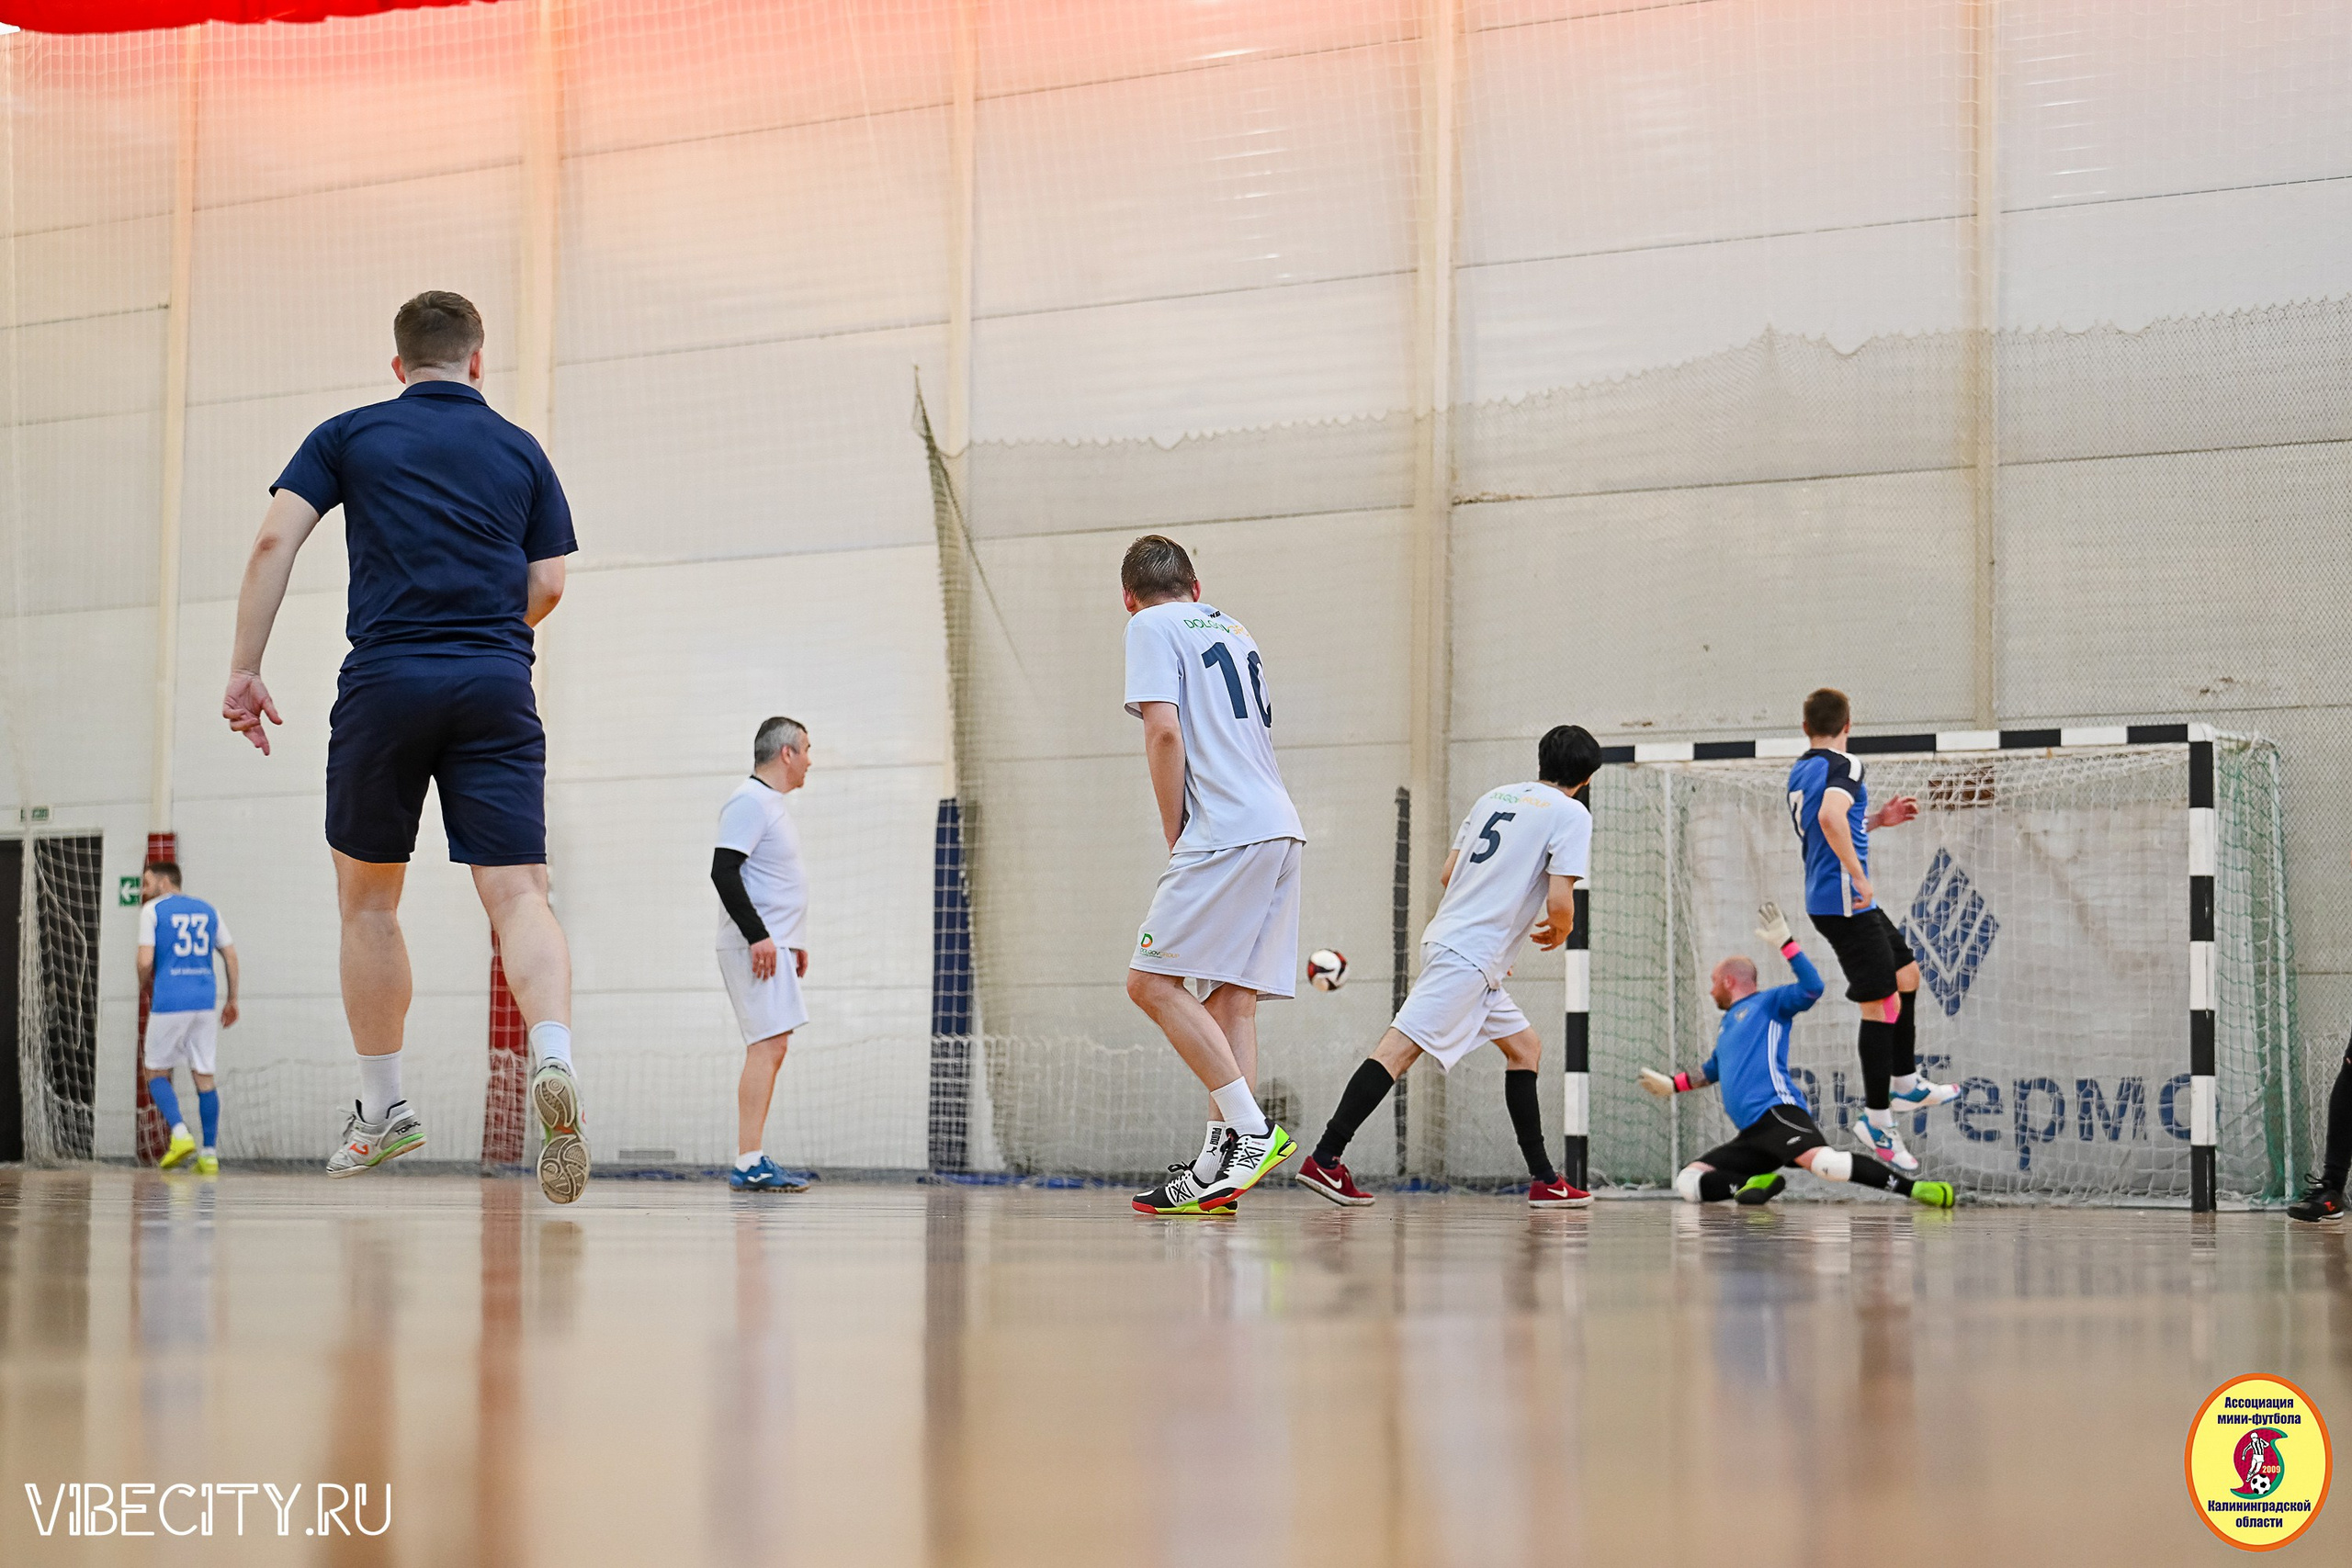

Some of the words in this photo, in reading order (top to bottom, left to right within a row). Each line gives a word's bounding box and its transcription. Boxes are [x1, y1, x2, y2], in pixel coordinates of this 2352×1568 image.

[1201, 641, 1272, 728] 10
[1469, 811, 1517, 864] 5
[171, 913, 209, 957] 33
